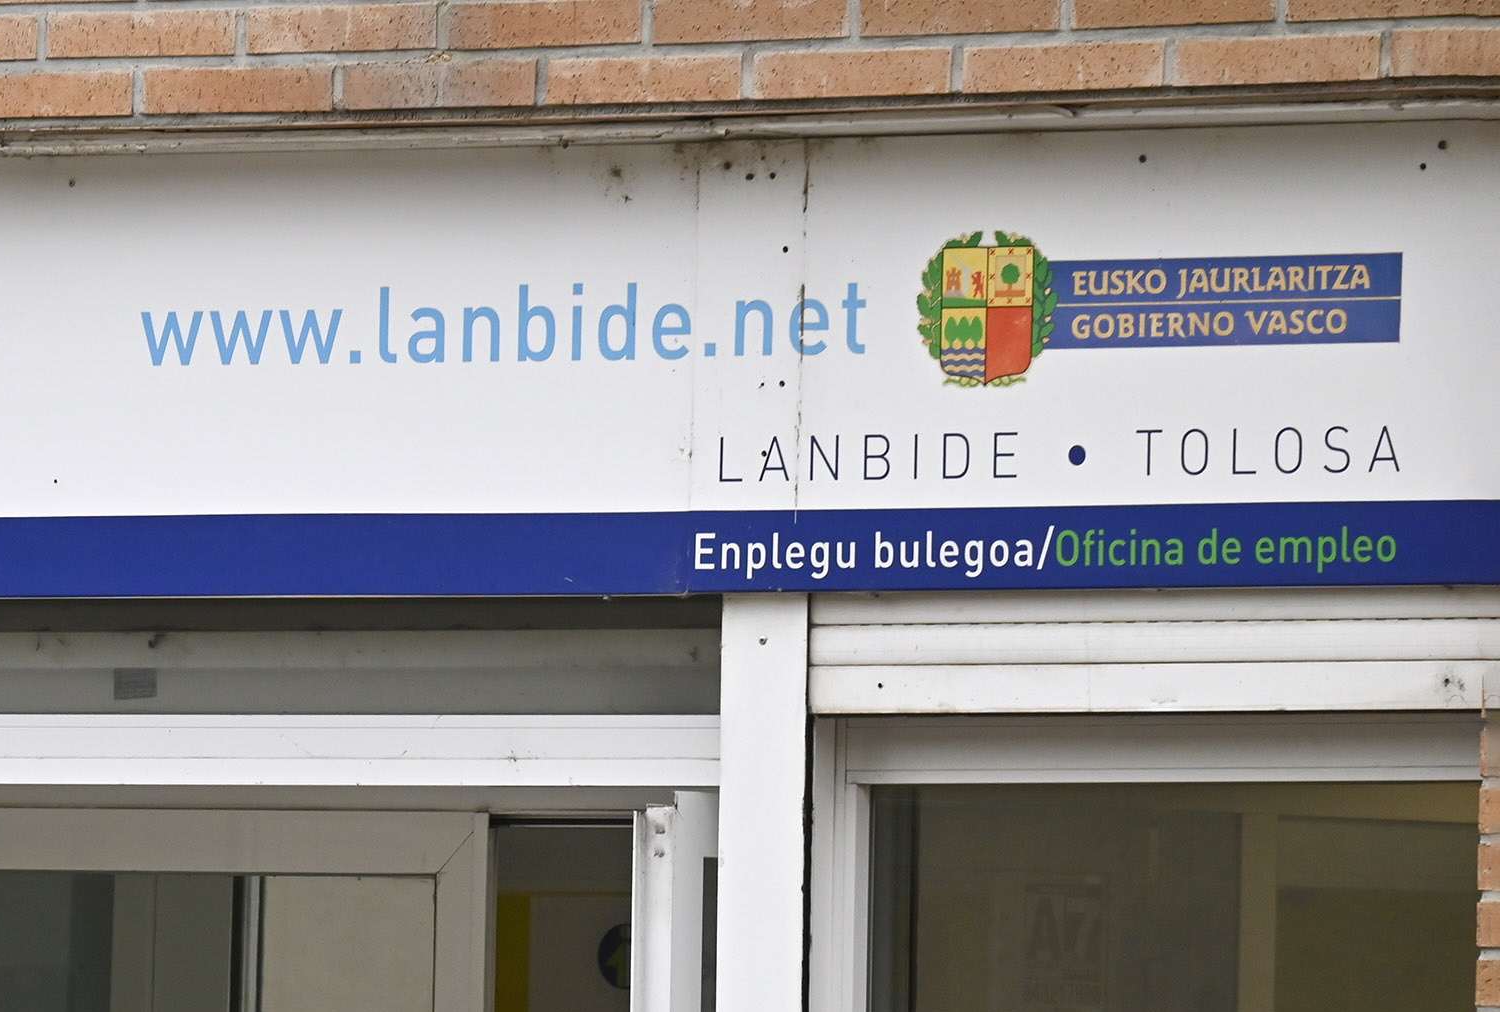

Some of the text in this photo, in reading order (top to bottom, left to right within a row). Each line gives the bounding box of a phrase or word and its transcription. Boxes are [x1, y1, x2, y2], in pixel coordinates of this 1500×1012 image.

[1072, 264, 1371, 299] EUSKO JAURLARITZA
[141, 282, 867, 366] www.lanbide.net
[1071, 308, 1348, 339] GOBIERNO VASCO
[718, 425, 1401, 483] LANBIDE TOLOSA
[694, 530, 857, 580] Enplegu
[1197, 528, 1242, 566] de
[1254, 525, 1398, 574] empleo
